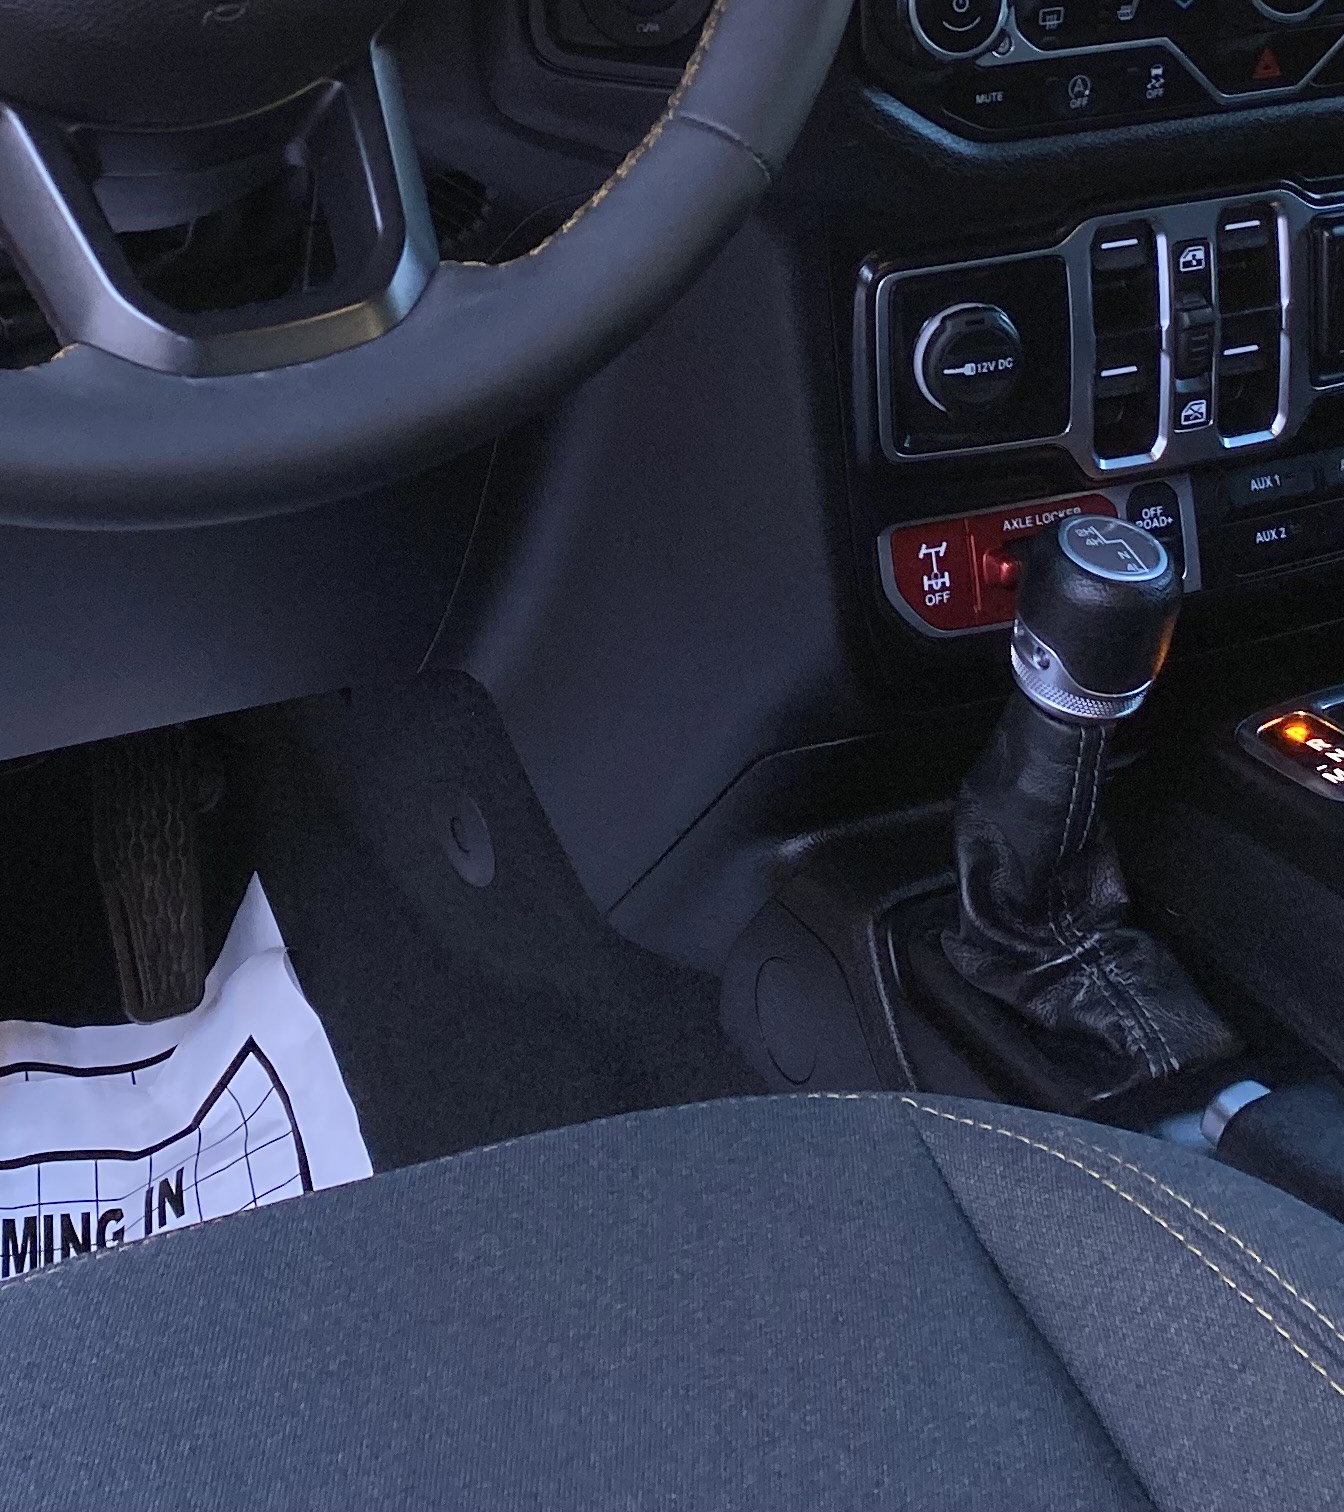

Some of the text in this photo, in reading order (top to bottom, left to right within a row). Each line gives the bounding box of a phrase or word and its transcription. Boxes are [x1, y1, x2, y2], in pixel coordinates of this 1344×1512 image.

[976, 91, 1004, 104] MUTE
[977, 357, 1014, 373] 12V DC
[1250, 475, 1273, 491] AUX
[1142, 506, 1163, 519] OFF
[1002, 516, 1033, 531] AXLE
[1256, 527, 1287, 544] AUX 2
[1117, 551, 1131, 560] N
[925, 591, 950, 606] OFF
[1305, 738, 1332, 752] R
[144, 1166, 186, 1239] IN
